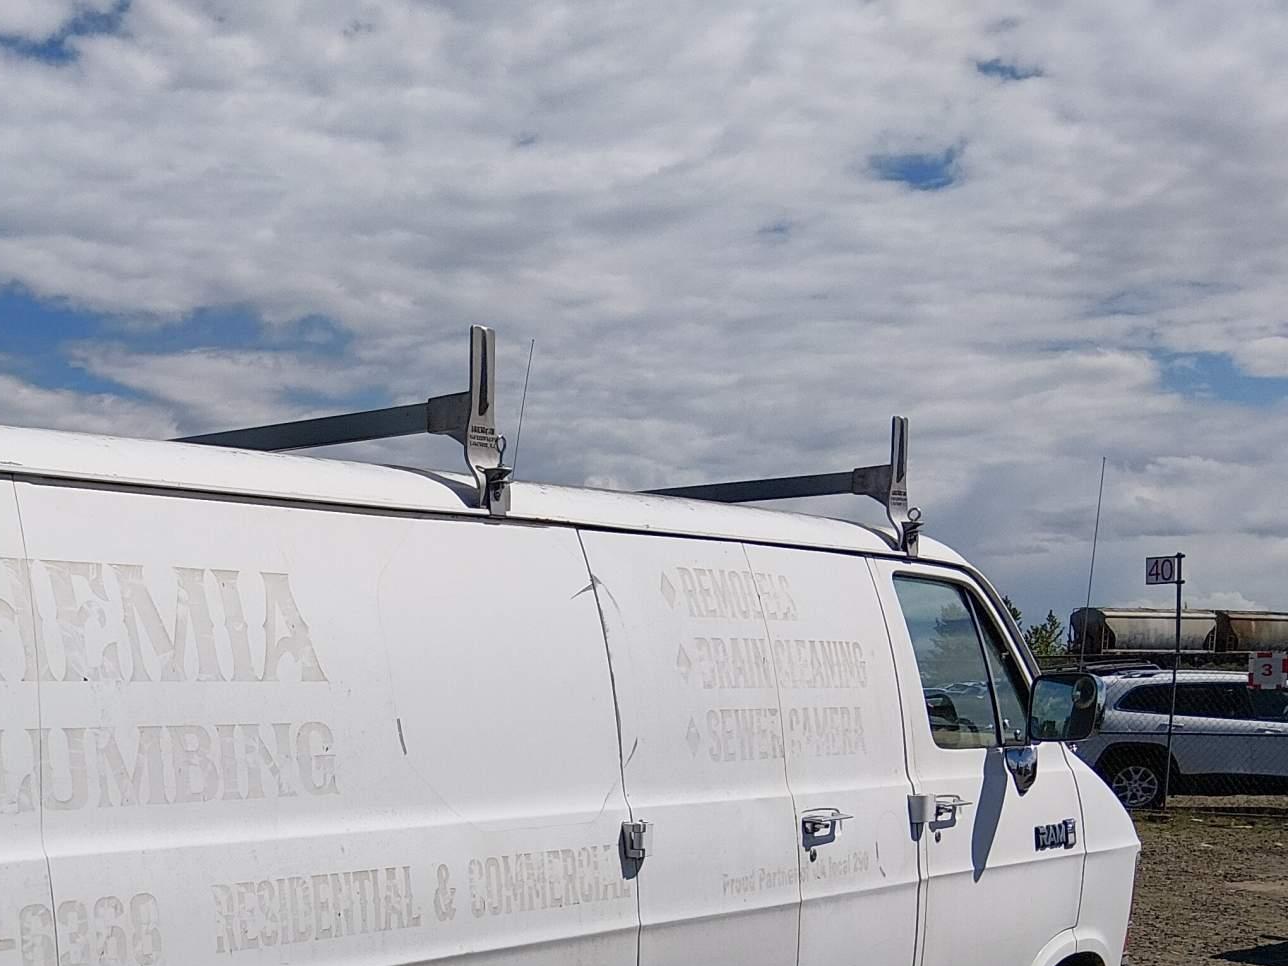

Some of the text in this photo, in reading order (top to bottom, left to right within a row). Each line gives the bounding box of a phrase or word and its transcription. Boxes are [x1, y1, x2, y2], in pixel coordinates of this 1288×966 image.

[1148, 559, 1173, 581] 40
[676, 567, 798, 622] REMODELS
[1262, 664, 1272, 677] 3
[706, 708, 785, 762] SEWER
[1034, 822, 1066, 852] RAM
[211, 866, 422, 953] RESIDENTIAL
[433, 863, 457, 921] &
